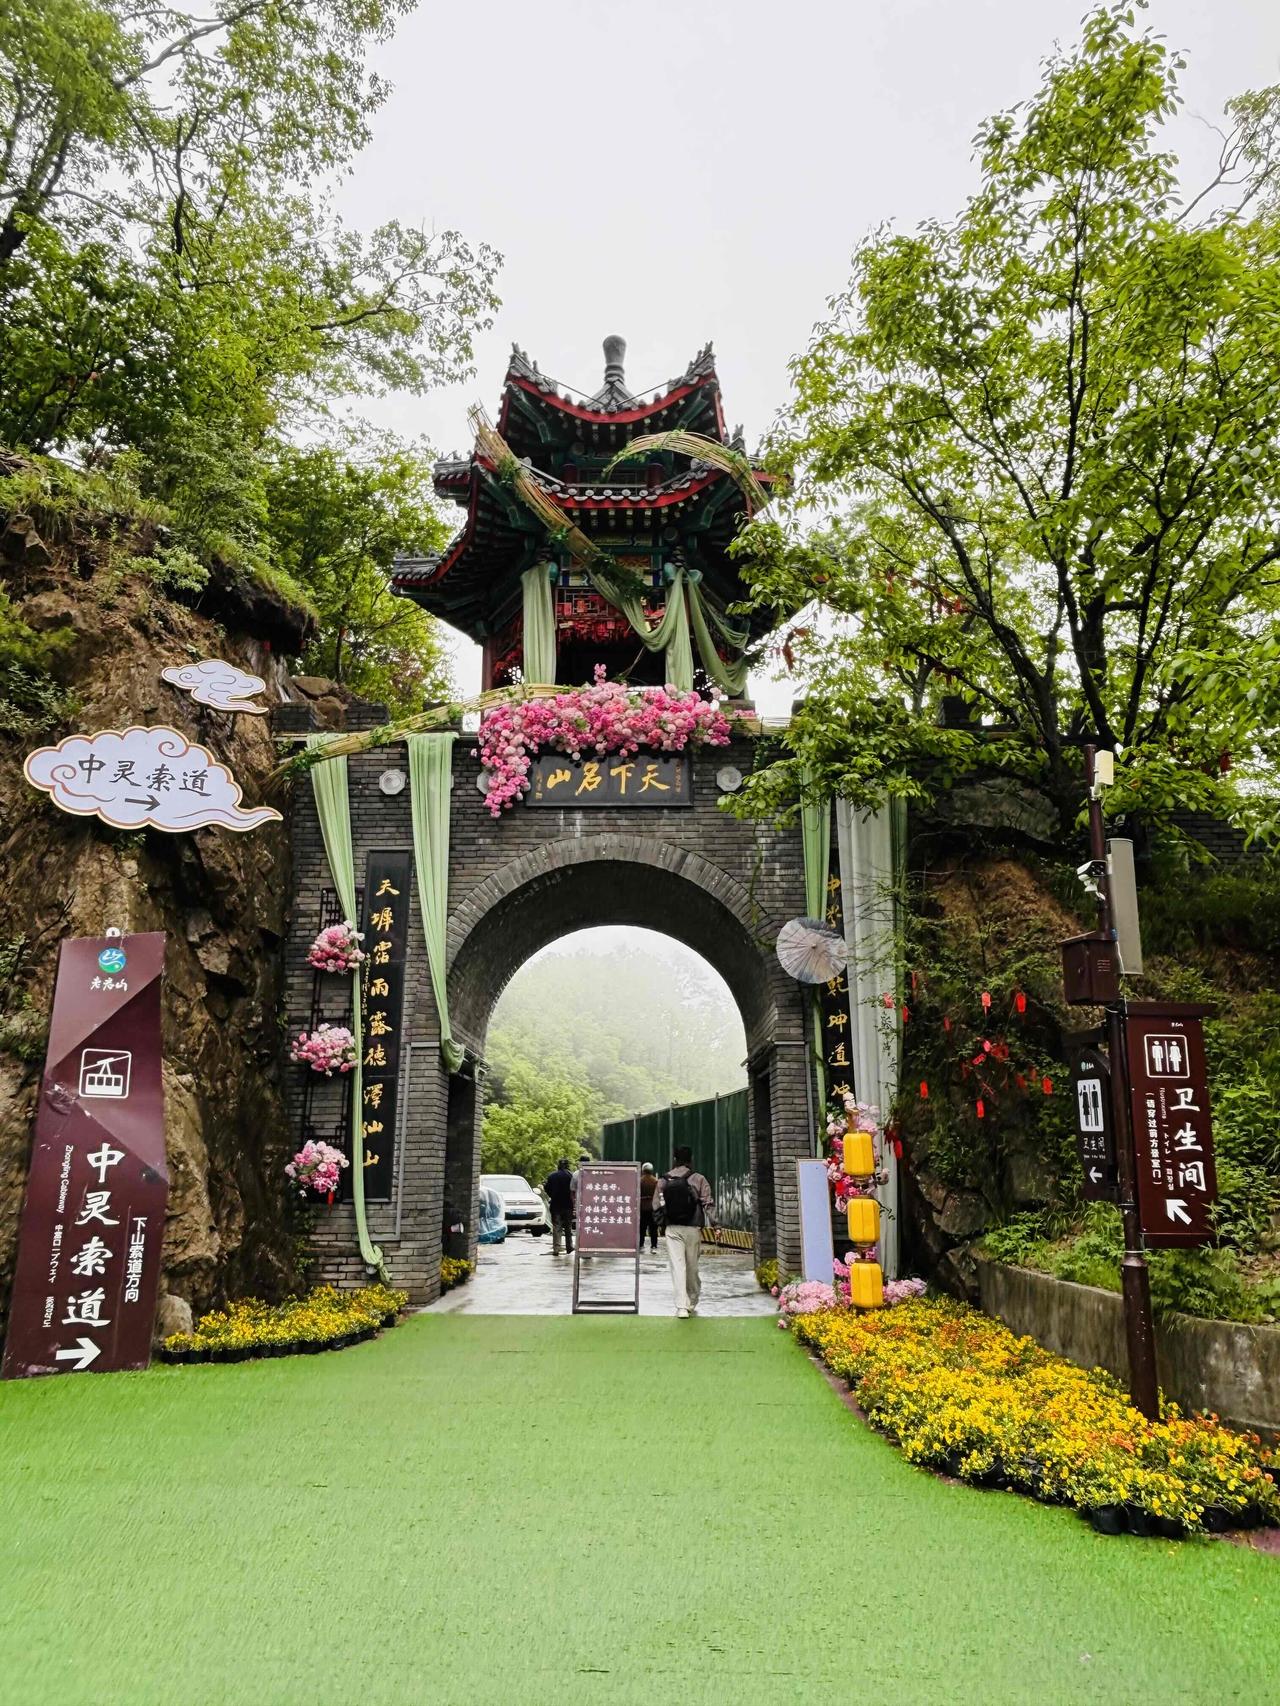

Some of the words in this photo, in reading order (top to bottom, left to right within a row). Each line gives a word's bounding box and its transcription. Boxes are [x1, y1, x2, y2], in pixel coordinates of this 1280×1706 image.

[78, 753, 212, 797] 中灵索道
[90, 975, 128, 991] 老君山
[60, 1144, 74, 1179] Zhongling
[1170, 1087, 1208, 1192] 卫生间
[56, 1179, 70, 1214] Cableway
[61, 1142, 126, 1328] 中灵索道
[124, 1216, 148, 1303] 下山索道方向
